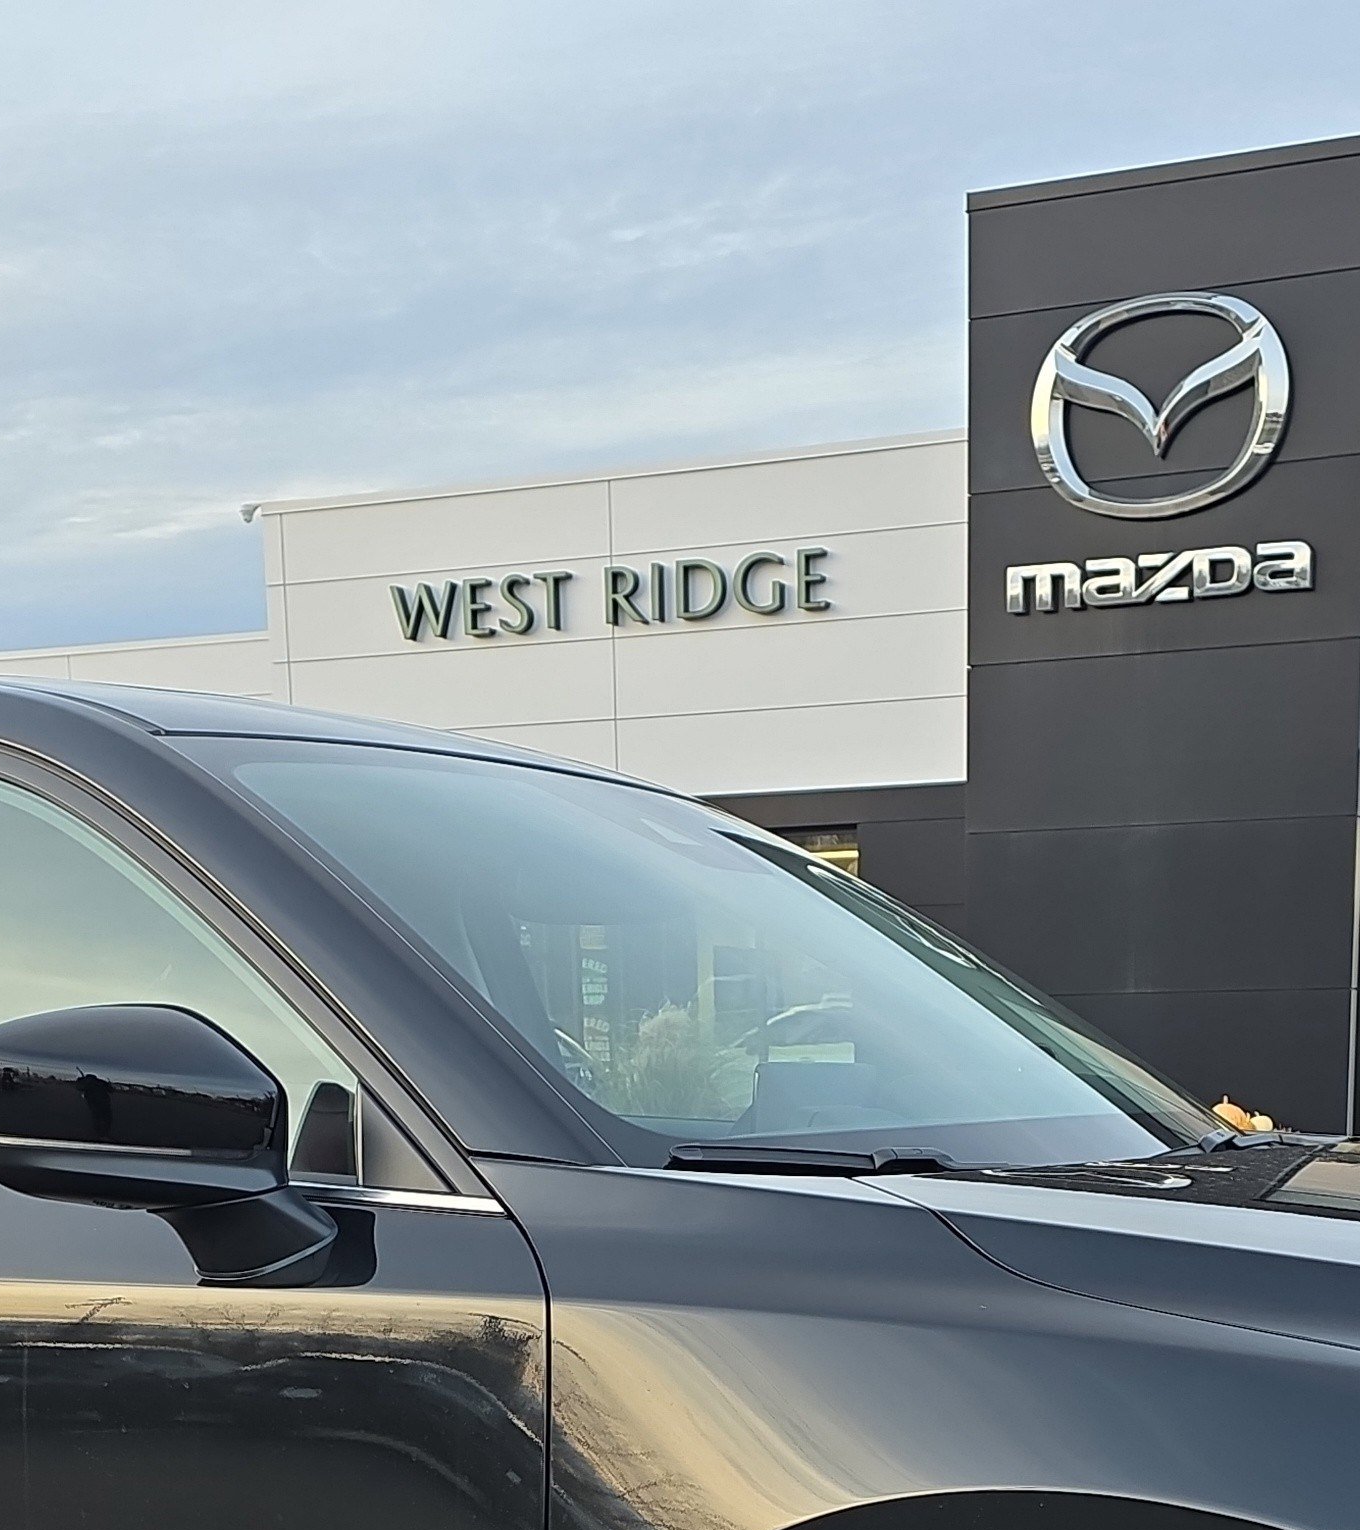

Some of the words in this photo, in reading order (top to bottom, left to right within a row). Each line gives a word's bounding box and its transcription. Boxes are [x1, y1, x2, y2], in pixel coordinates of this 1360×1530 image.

[389, 570, 574, 642] WEST
[604, 547, 831, 625] RIDGE
[1006, 541, 1315, 613] mazda
